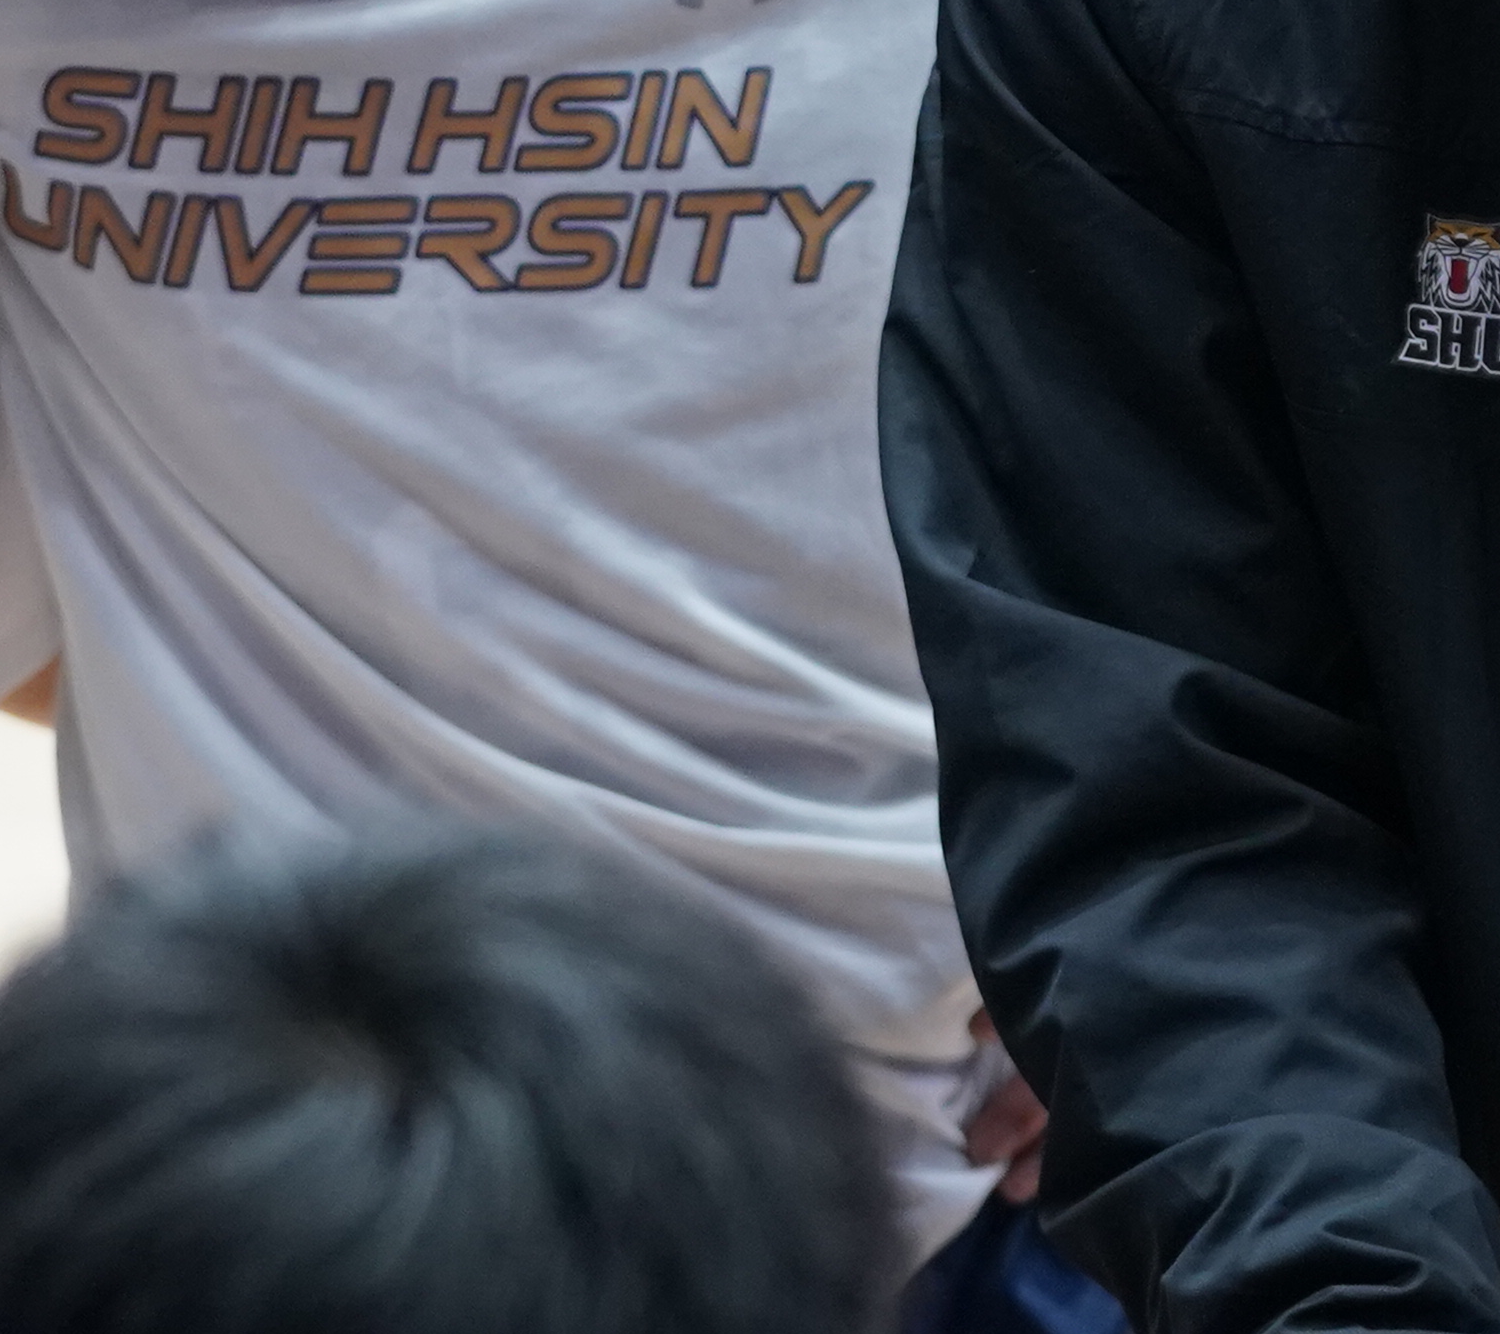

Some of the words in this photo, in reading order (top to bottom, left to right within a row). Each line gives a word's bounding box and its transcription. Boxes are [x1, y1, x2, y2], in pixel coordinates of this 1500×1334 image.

[33, 67, 394, 177] SHIH
[406, 67, 773, 175] HSIN
[0, 159, 876, 295] UNIVERSITY
